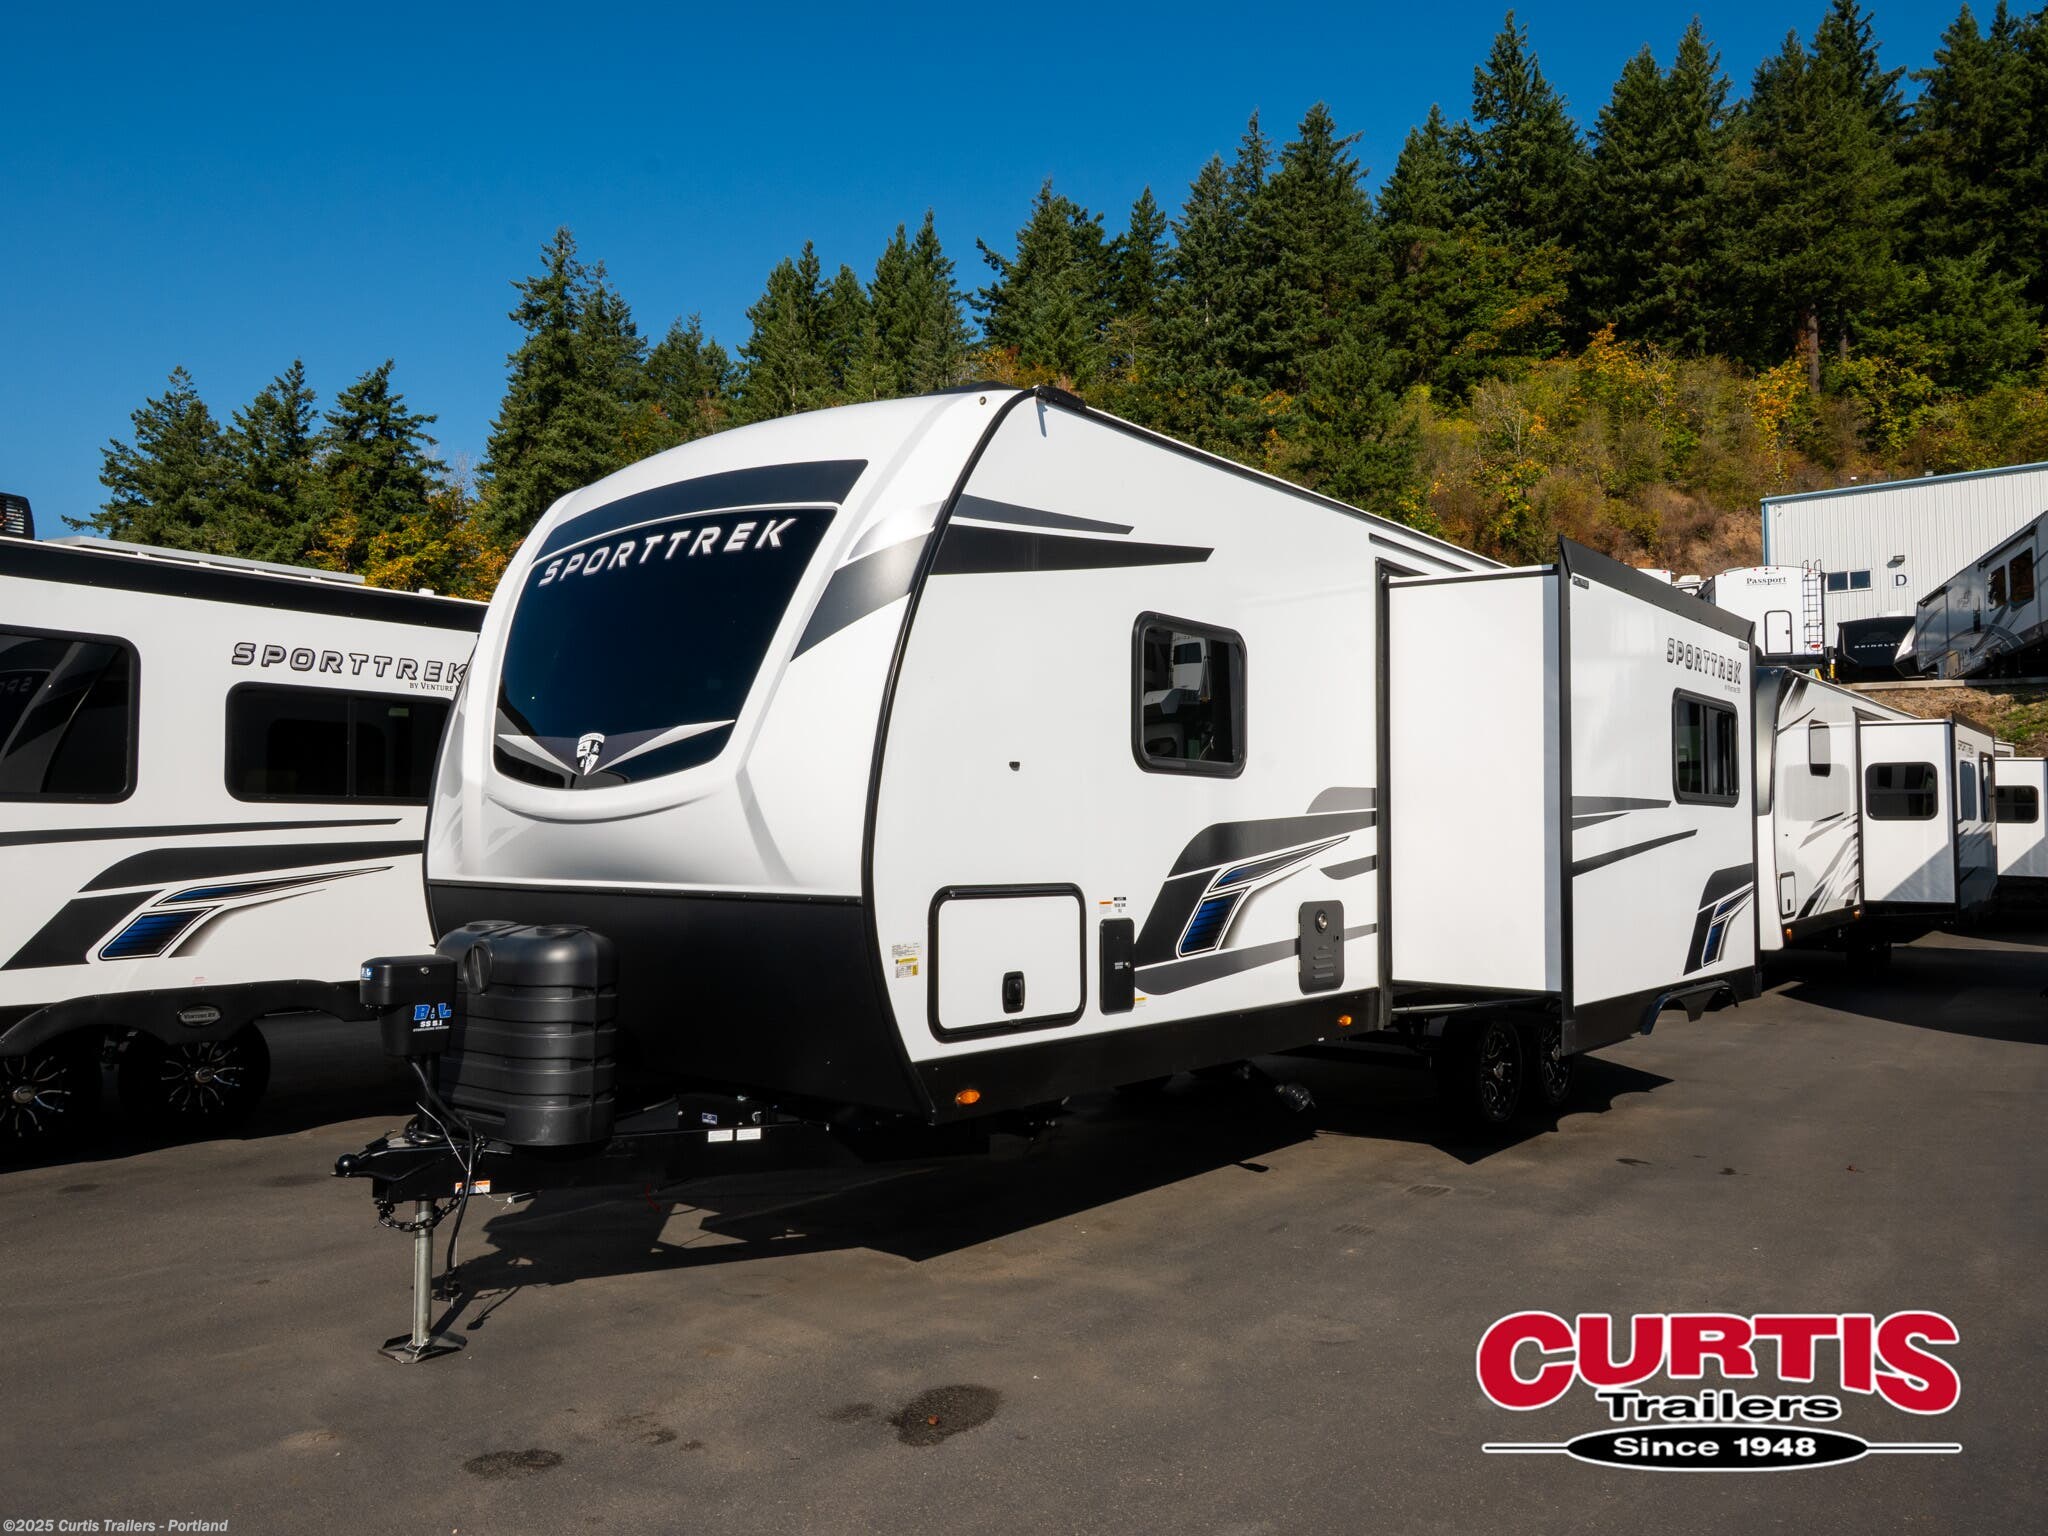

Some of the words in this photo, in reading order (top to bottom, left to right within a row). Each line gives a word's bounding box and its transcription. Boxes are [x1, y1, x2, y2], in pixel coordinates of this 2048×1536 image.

[537, 517, 799, 588] SPORTTREK
[1746, 577, 1787, 585] Passport
[1895, 574, 1907, 587] D
[231, 642, 468, 683] SPORTTREK
[1666, 637, 1742, 685] SPORTTREK
